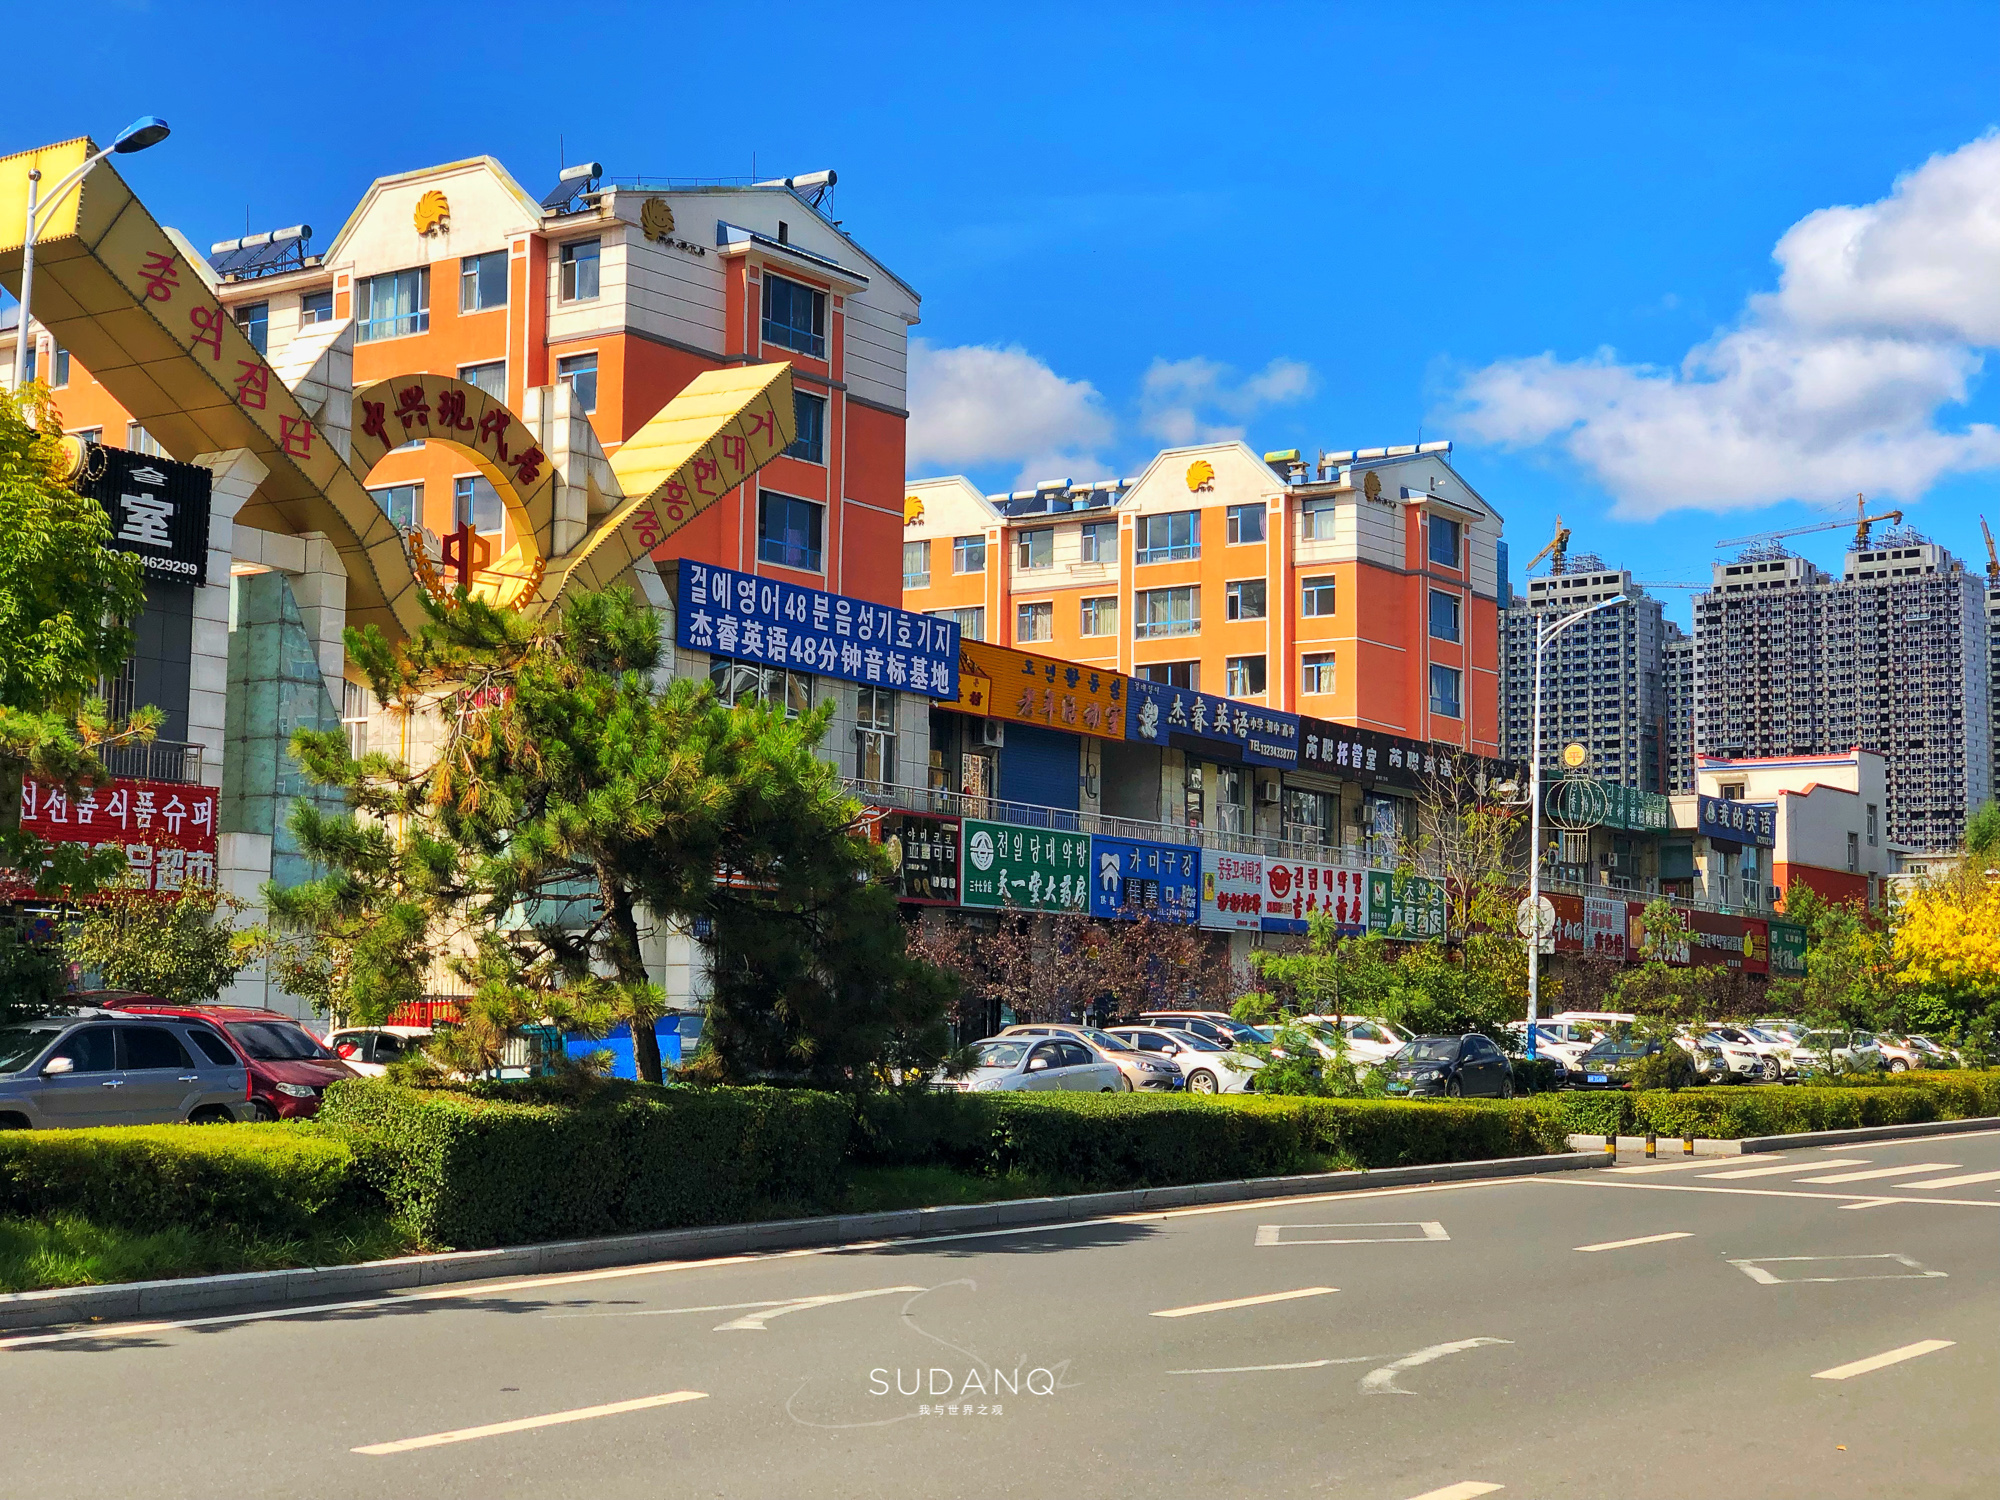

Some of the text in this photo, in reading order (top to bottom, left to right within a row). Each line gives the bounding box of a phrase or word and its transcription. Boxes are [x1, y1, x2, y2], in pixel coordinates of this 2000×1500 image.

[689, 609, 950, 695] 杰睿英语48分钟音标基地
[1167, 693, 1249, 738] 杰睿英语
[1718, 803, 1772, 835] 我的英语
[997, 831, 1087, 868] 천일당대약방
[1129, 848, 1193, 877] 가미구강
